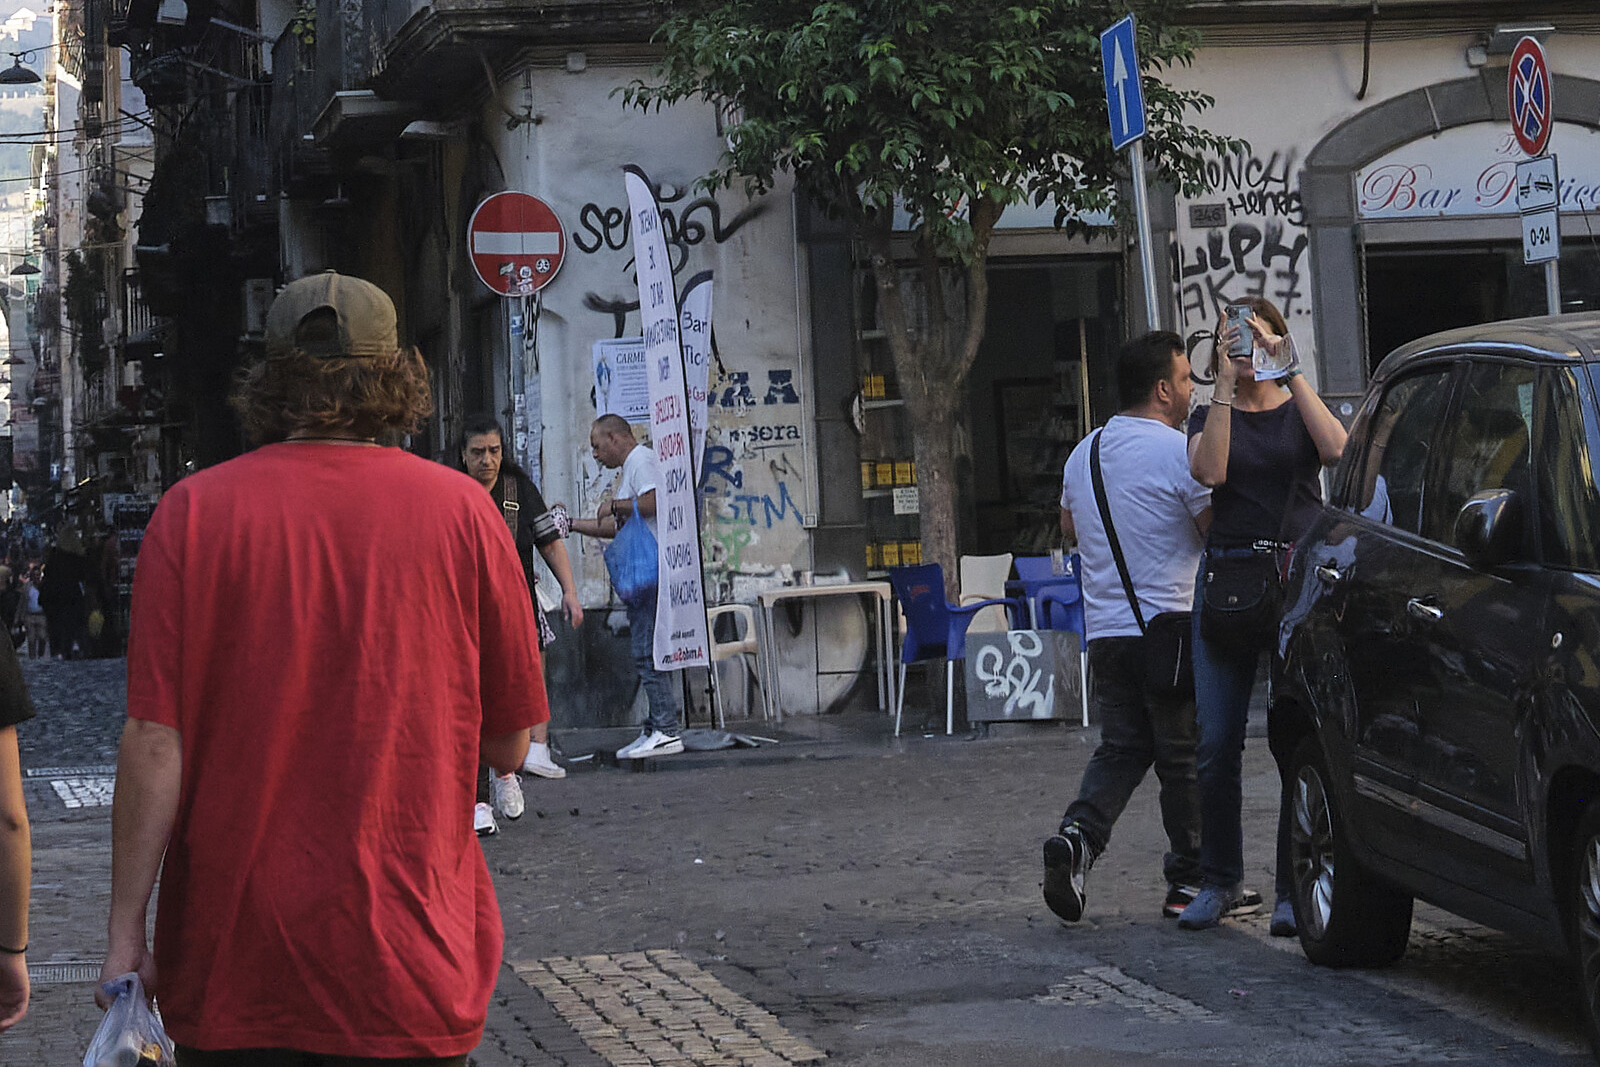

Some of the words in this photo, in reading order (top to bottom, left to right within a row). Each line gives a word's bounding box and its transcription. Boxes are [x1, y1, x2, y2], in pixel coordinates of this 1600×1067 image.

[1361, 163, 1461, 212] Bar
[1530, 226, 1551, 246] 0-24
[682, 311, 708, 334] Bar
